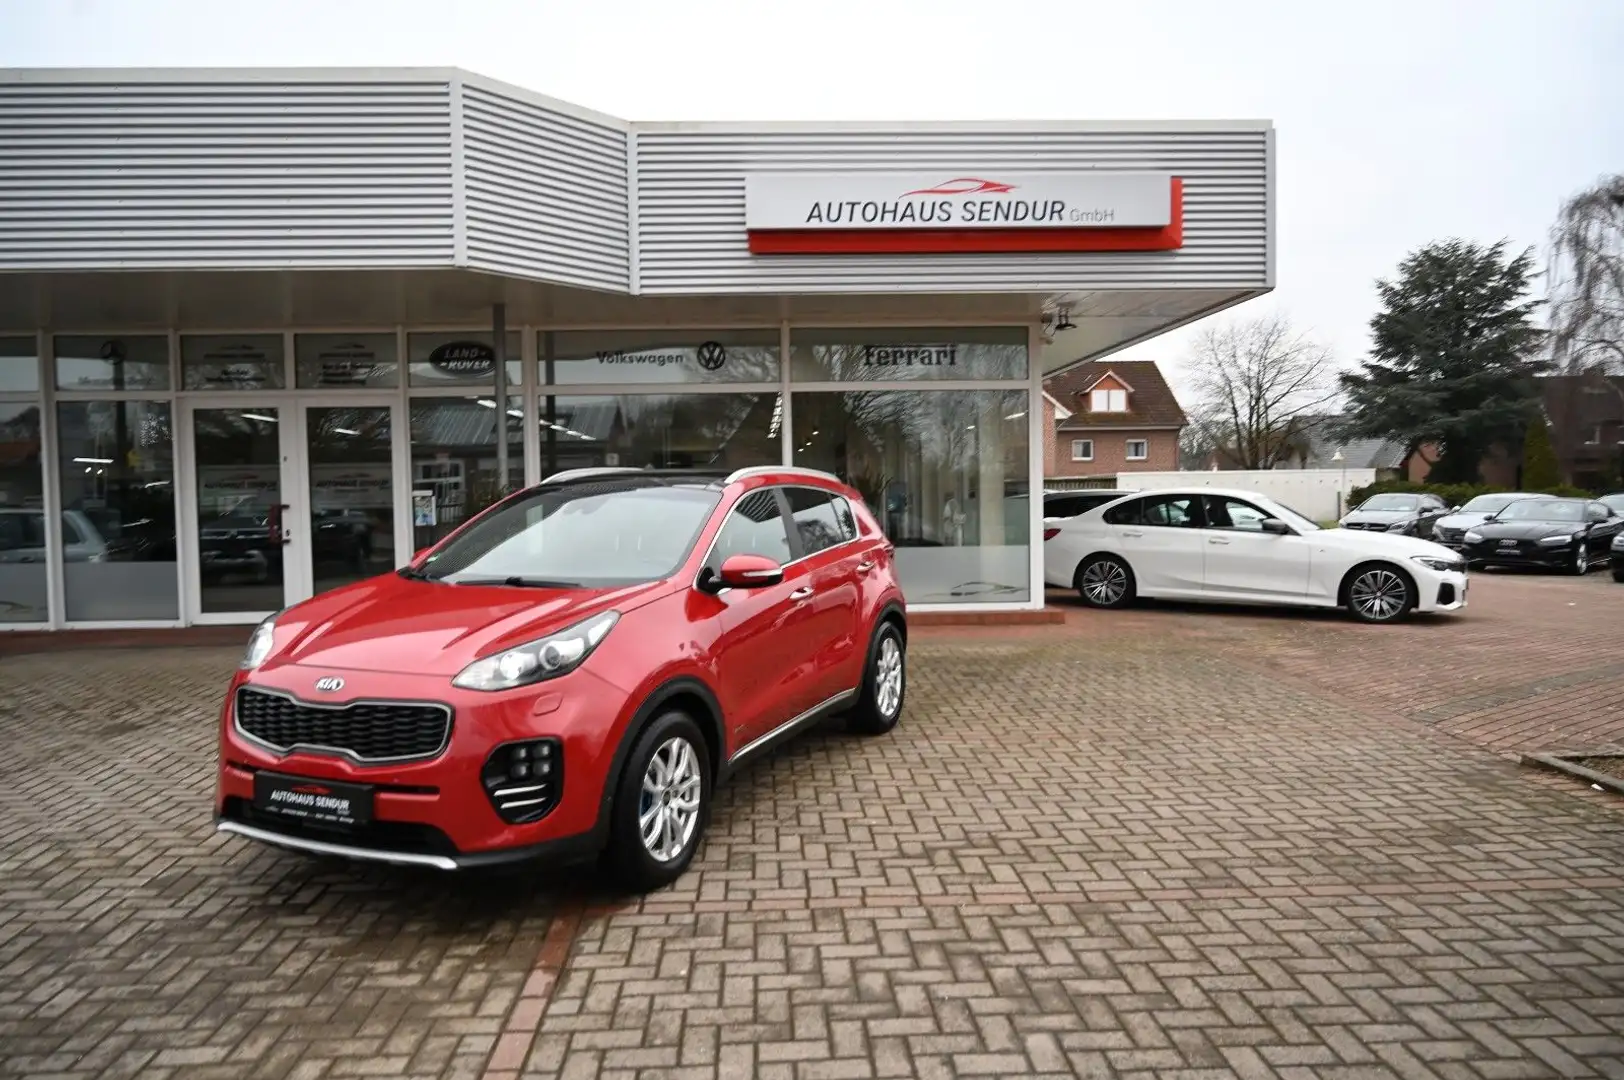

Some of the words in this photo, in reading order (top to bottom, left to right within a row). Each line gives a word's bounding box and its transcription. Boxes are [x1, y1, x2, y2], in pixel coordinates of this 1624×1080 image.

[805, 201, 953, 223] AUTOHAUS
[961, 200, 1066, 222] SENDUR
[1069, 208, 1115, 222] GmbH
[596, 350, 684, 366] Volkswagen
[863, 344, 956, 366] Ferrari
[316, 678, 338, 690] KIA
[270, 789, 315, 806] AUTOHAUS
[315, 795, 350, 810] SENDUR
